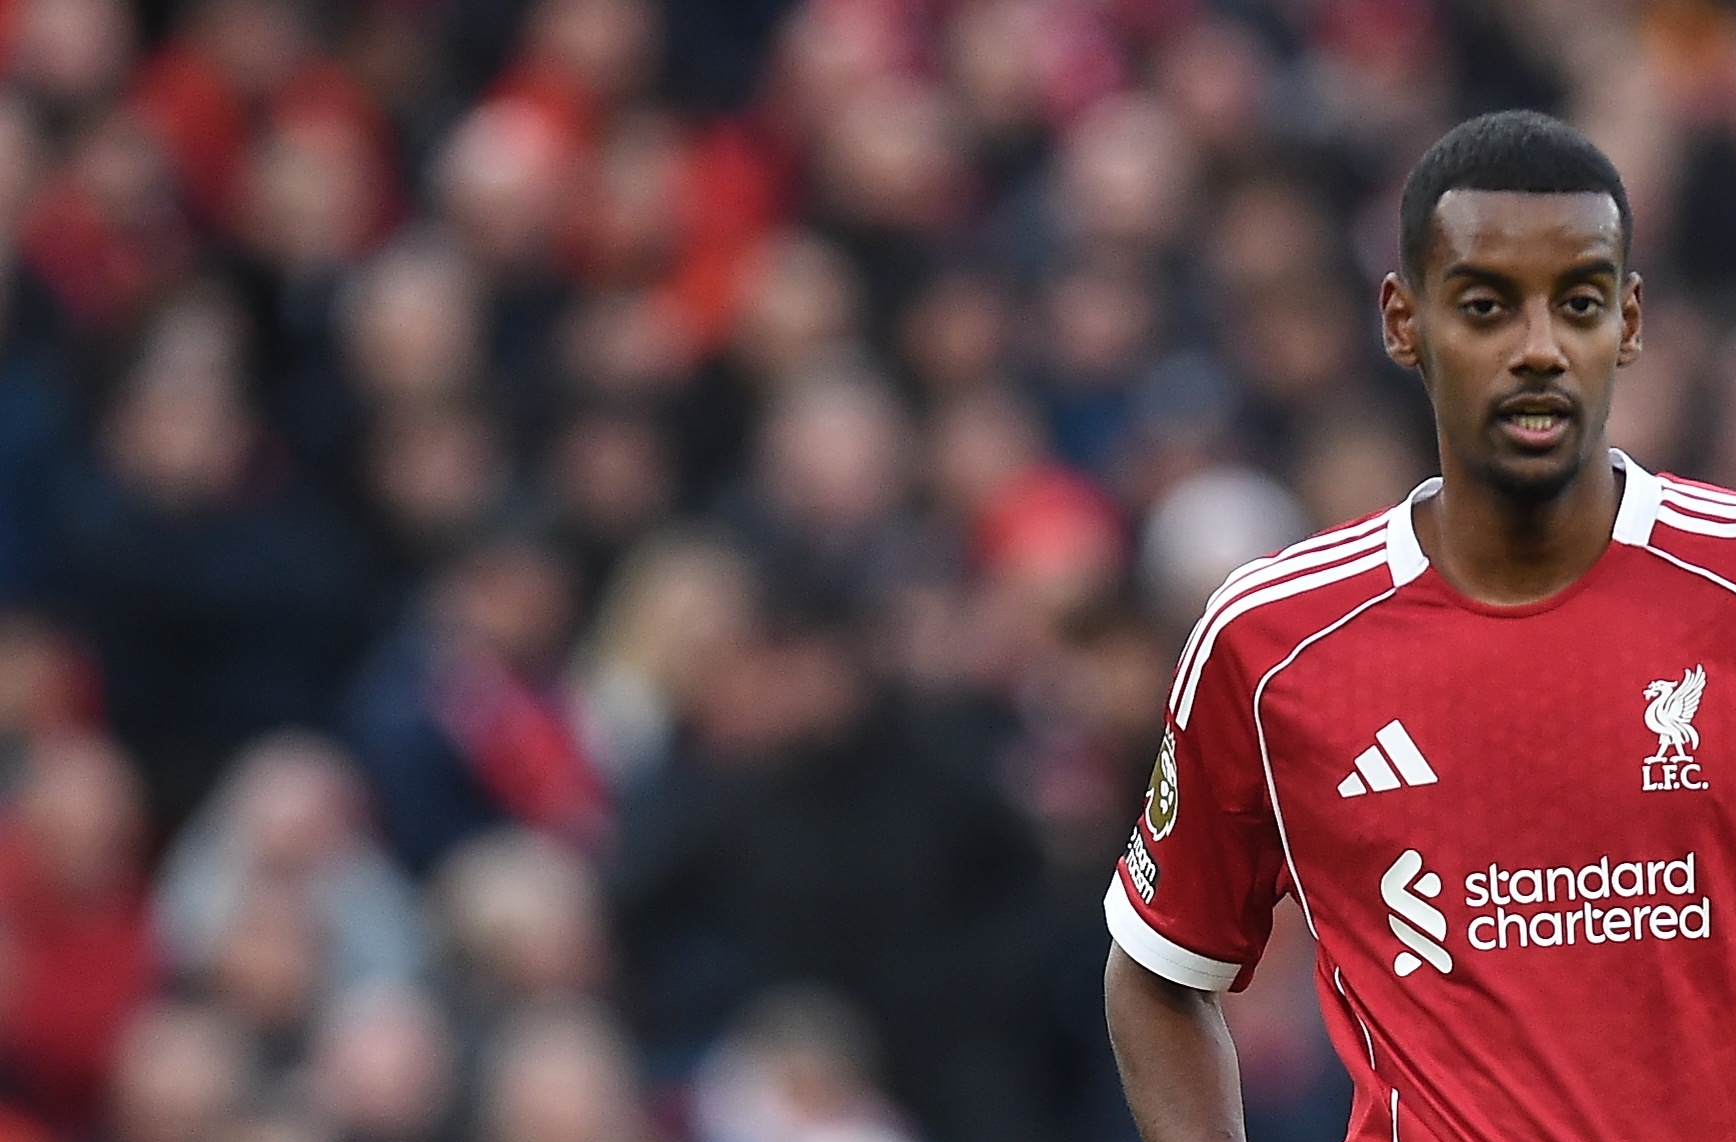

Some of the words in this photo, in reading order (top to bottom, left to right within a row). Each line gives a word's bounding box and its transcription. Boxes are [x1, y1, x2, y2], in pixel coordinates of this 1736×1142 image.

[1642, 764, 1709, 791] L.F.C.
[1465, 851, 1695, 907] standard
[1467, 896, 1710, 950] chartered
